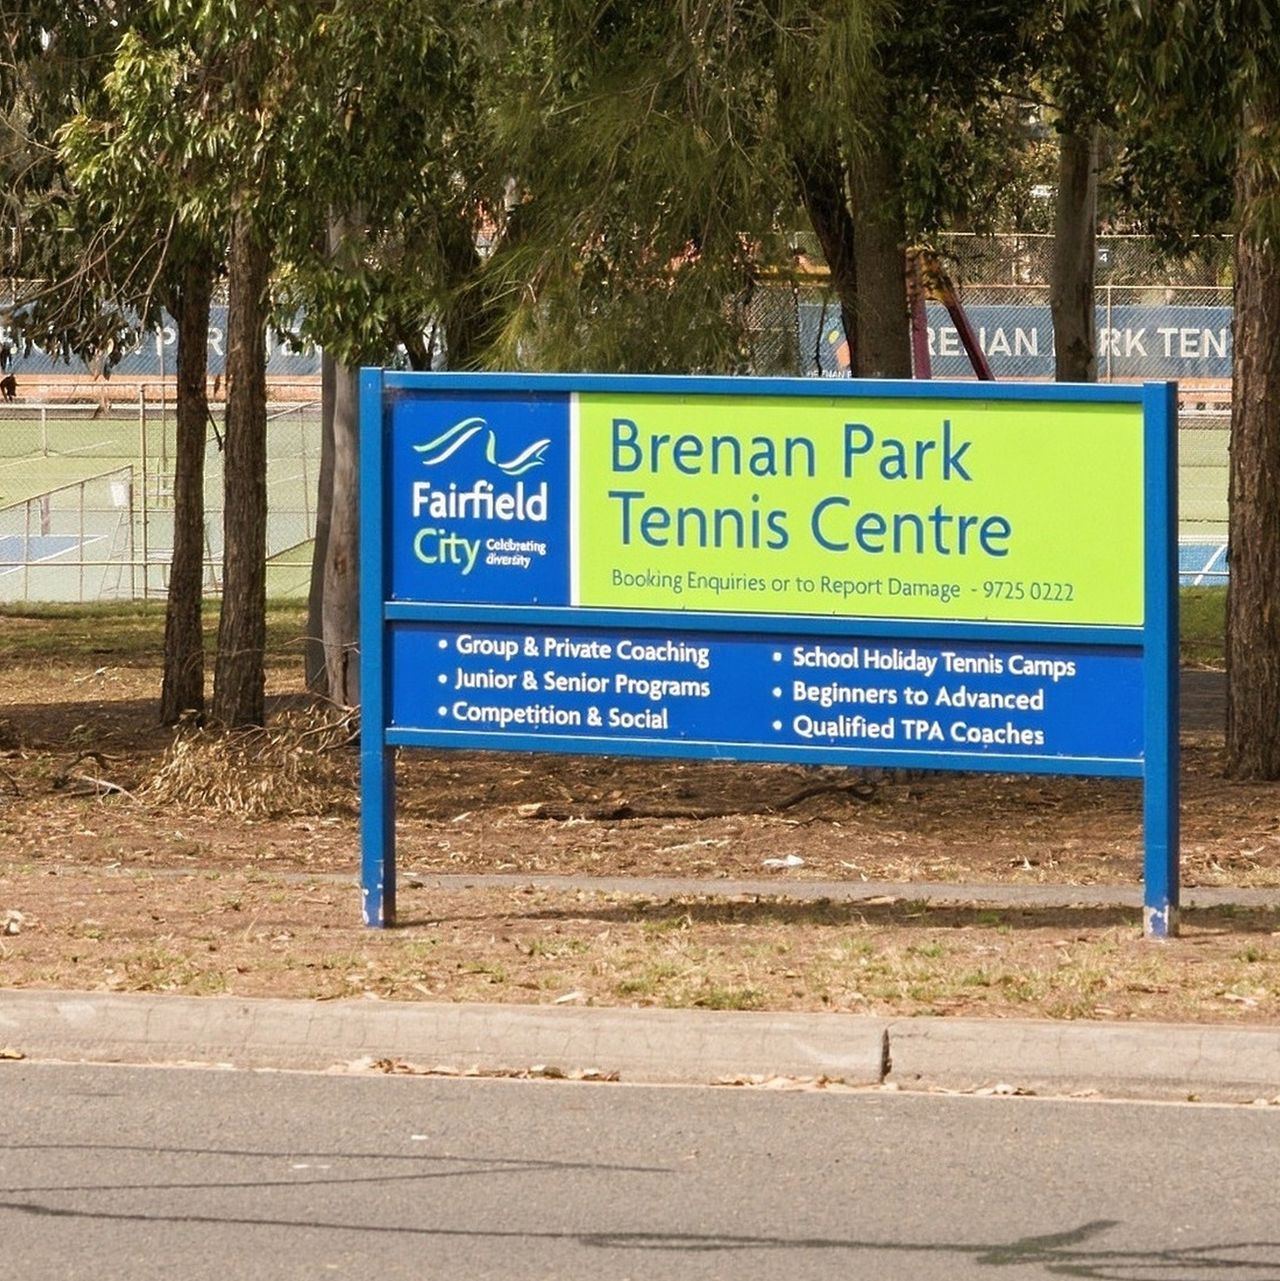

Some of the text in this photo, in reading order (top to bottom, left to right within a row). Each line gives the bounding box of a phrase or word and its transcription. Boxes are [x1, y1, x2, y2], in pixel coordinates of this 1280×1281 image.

[926, 327, 1038, 356] REAN
[1157, 328, 1227, 358] TEN
[611, 418, 973, 481] Brenan Park
[412, 479, 548, 521] Fairfield
[608, 490, 1012, 557] Tennis Centre
[413, 527, 480, 576] City
[486, 537, 546, 555] Celebrating
[486, 553, 531, 569] diversity
[612, 569, 682, 593] Booking
[688, 571, 766, 595] Enquiries
[772, 579, 790, 592] or
[795, 577, 814, 593] to
[821, 576, 882, 598] Report
[888, 578, 960, 603] Damage
[983, 580, 1025, 600] 9725
[1030, 582, 1074, 602] 0222
[456, 635, 710, 668] Group & Private Coaching
[793, 646, 1076, 682] School Holiday Tennis Camps
[455, 668, 710, 701] Junior & Senior Programs
[793, 681, 1044, 710] Beginners to Advanced
[452, 701, 668, 729] Competition & Social
[793, 715, 1044, 745] Qualified TPA Coaches
